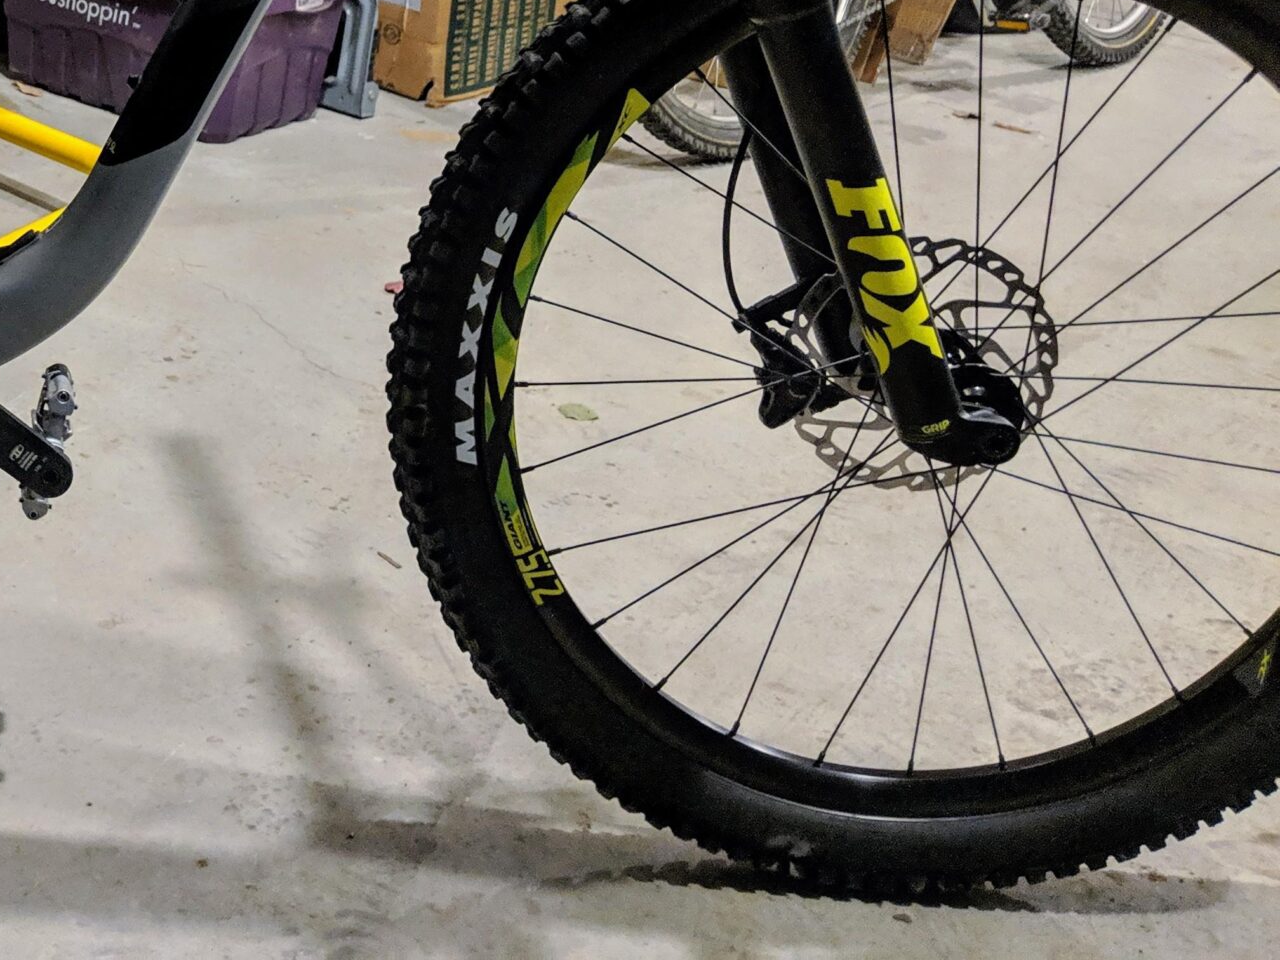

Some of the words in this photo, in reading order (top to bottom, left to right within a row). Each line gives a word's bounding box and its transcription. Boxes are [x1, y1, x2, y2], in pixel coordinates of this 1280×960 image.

[826, 178, 944, 374] FOX
[455, 207, 517, 465] MAXXIS
[921, 419, 950, 434] GRIP
[502, 500, 522, 551] GIANT
[513, 548, 565, 606] 27.5
